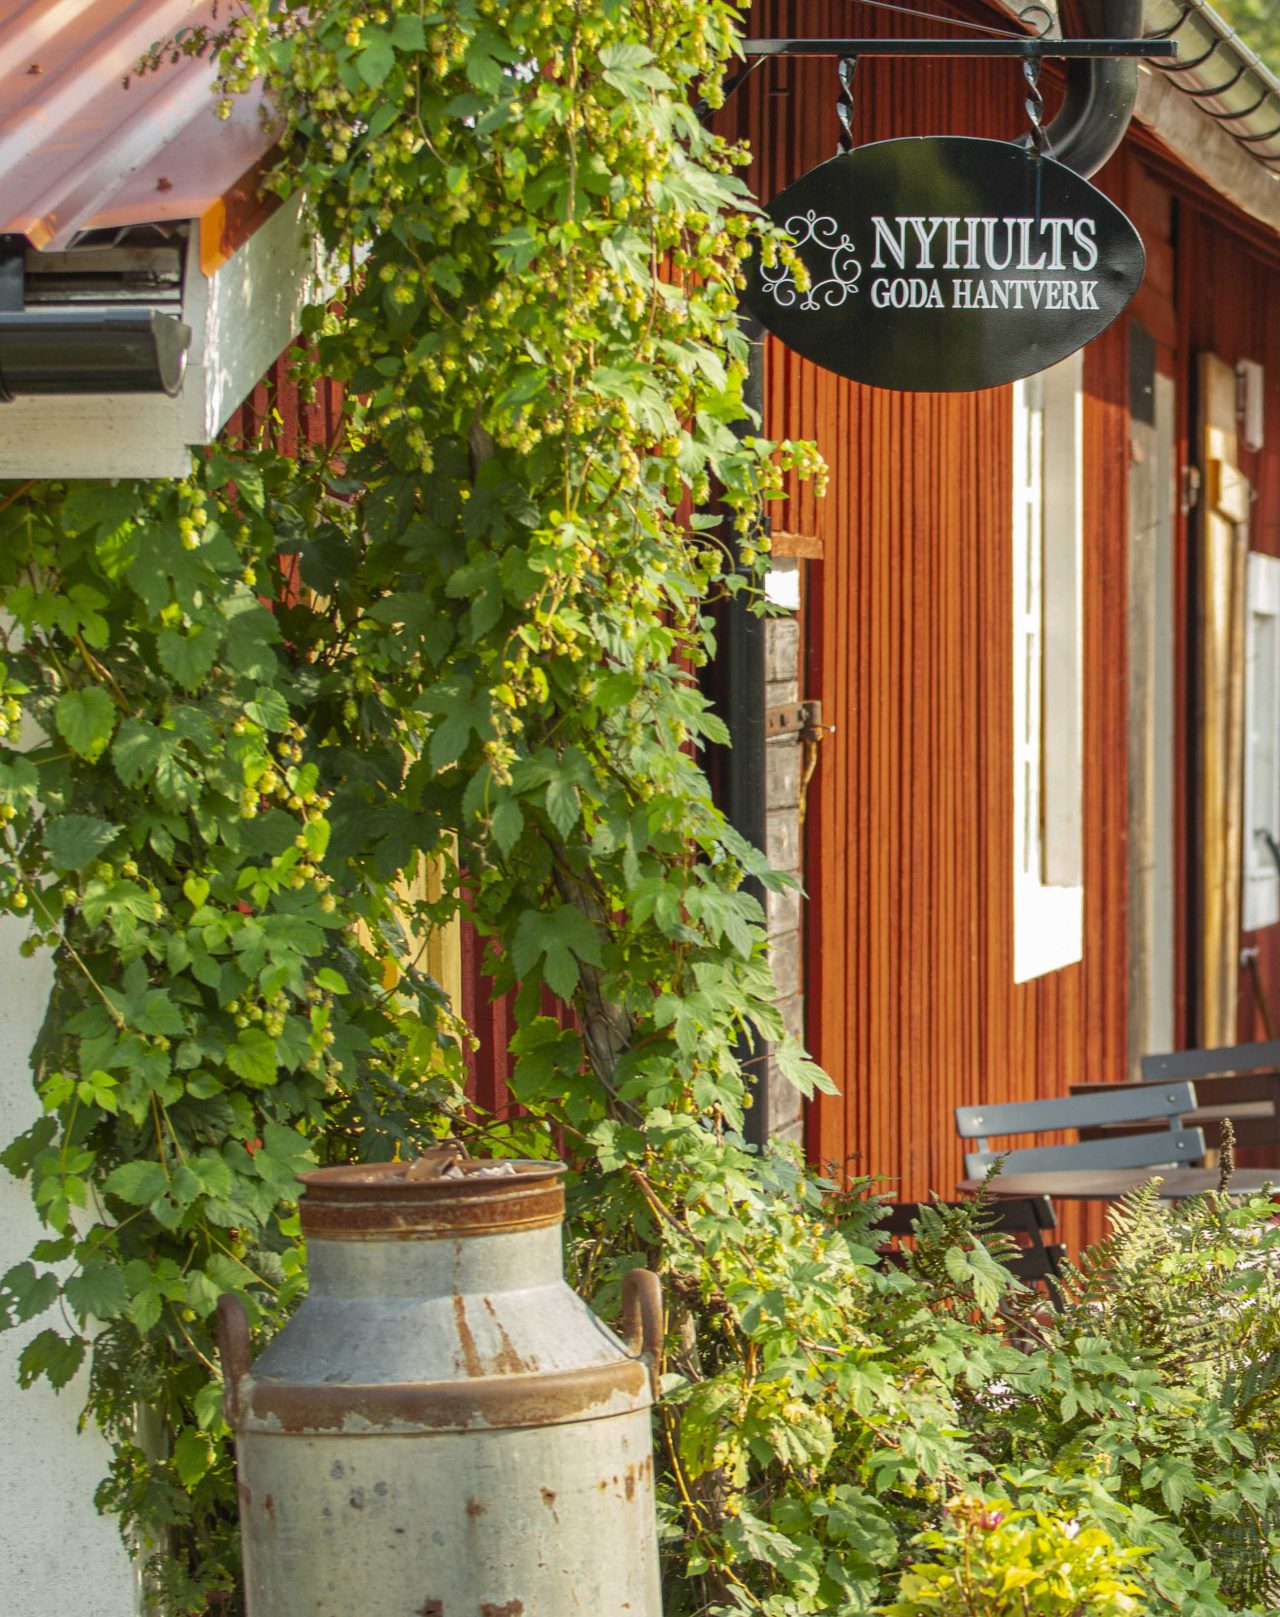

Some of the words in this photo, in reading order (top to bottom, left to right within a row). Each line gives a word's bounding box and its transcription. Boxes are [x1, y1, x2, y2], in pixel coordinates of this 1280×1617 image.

[870, 216, 1099, 271] NYHULTS
[870, 278, 945, 309] GODA
[952, 279, 1100, 310] HANTVERK
